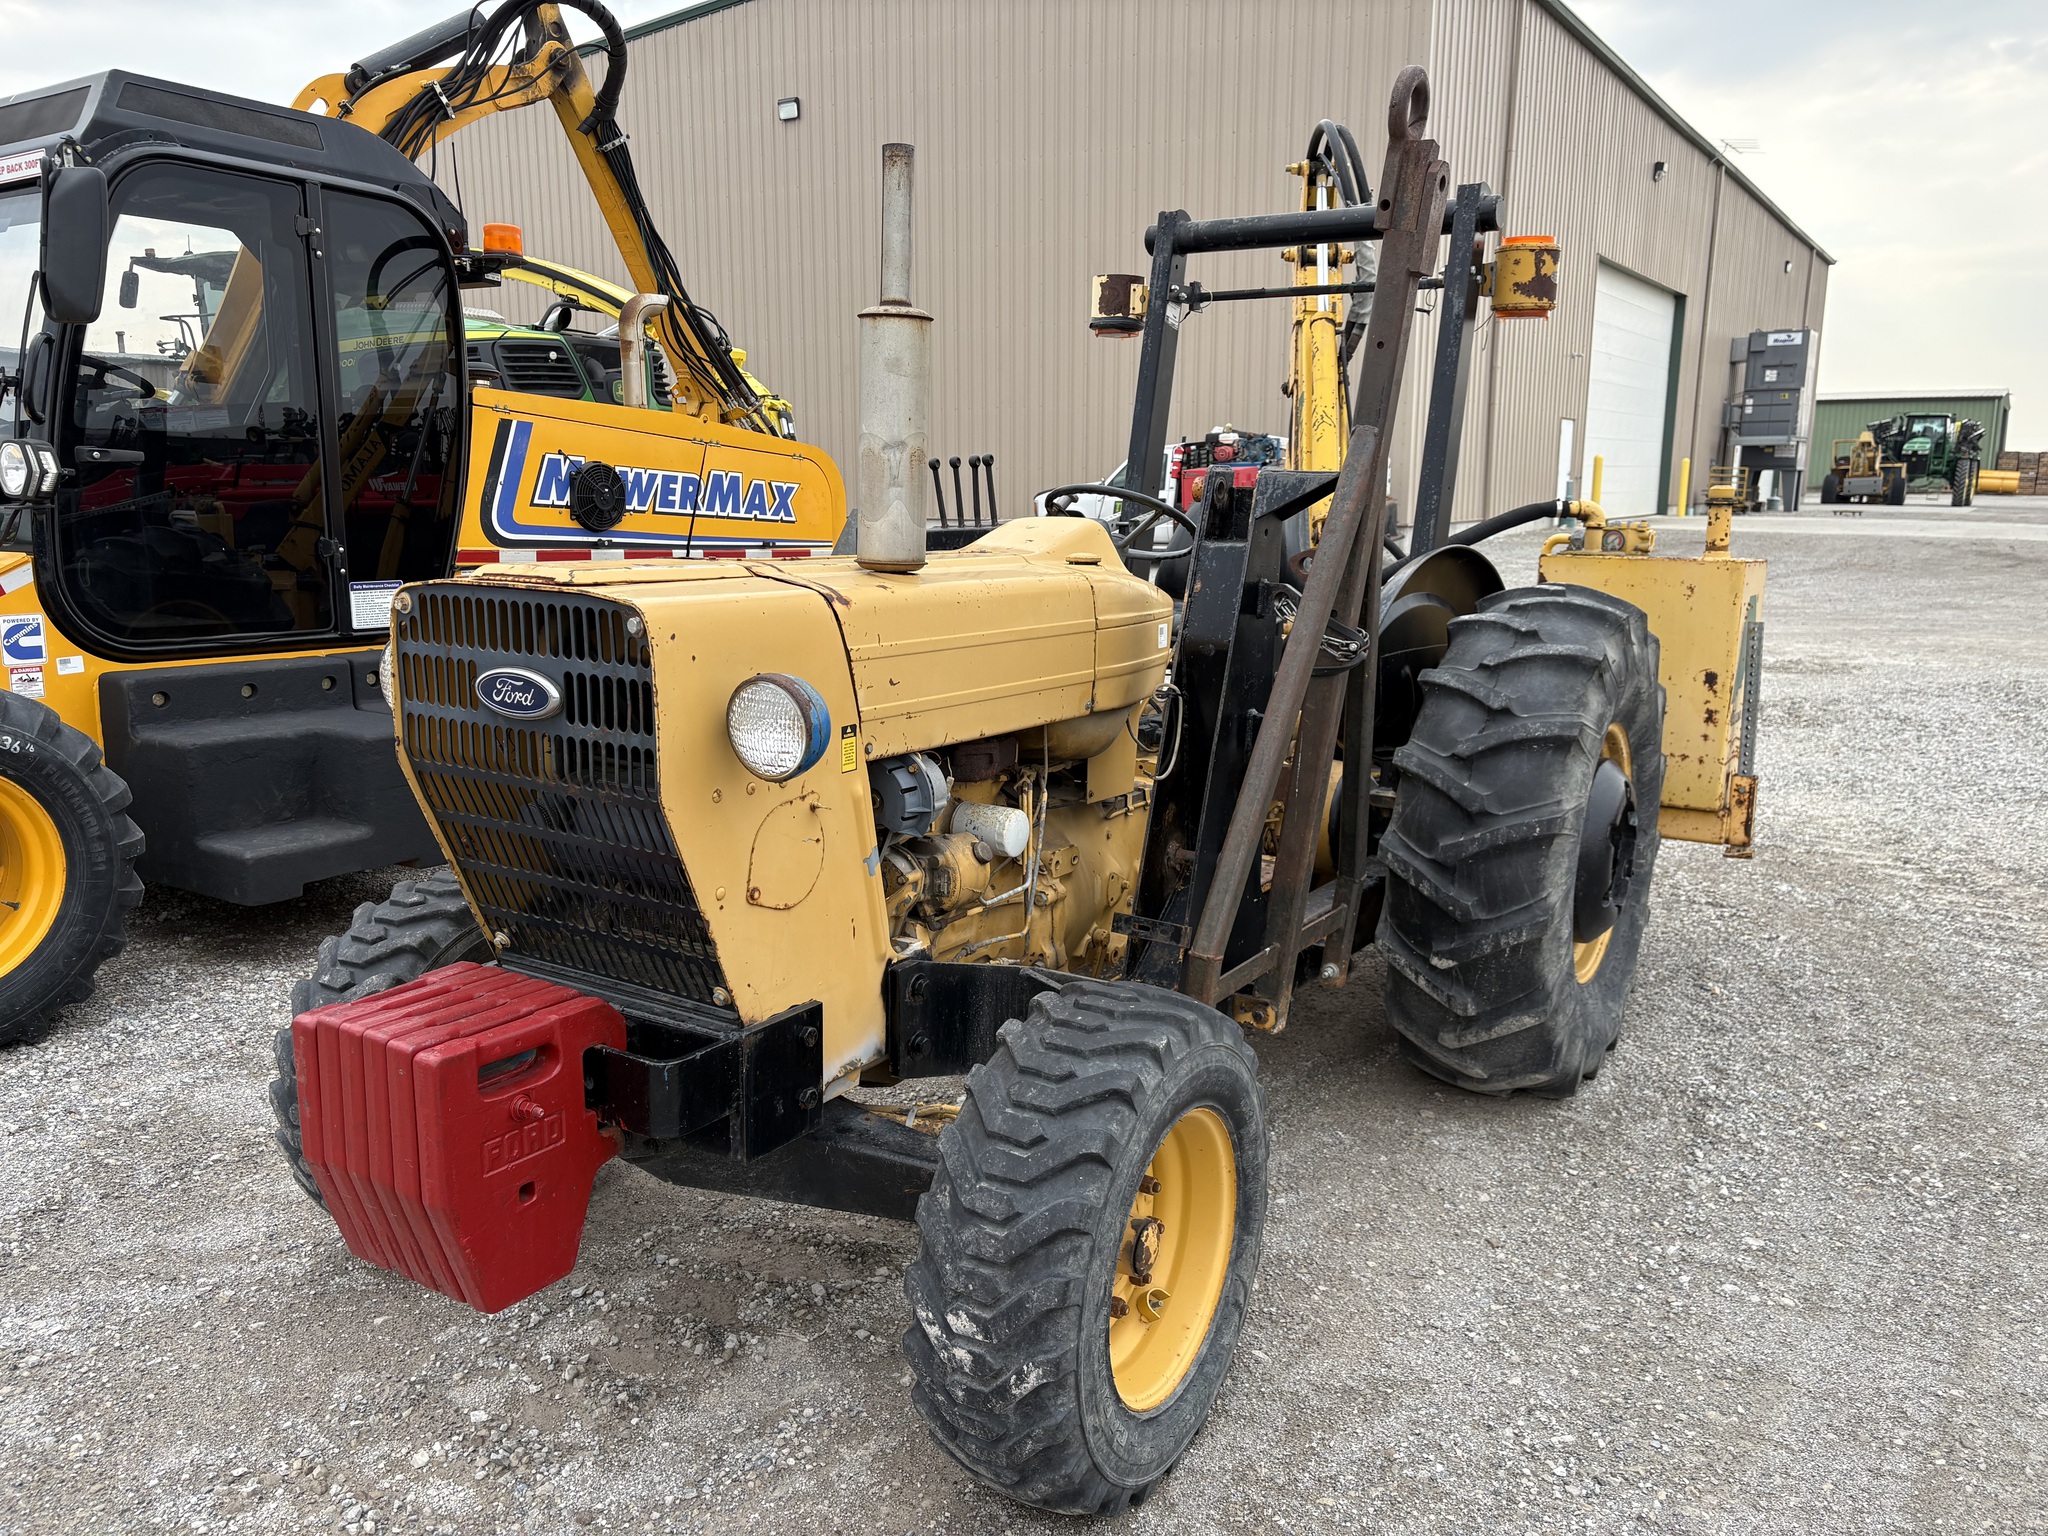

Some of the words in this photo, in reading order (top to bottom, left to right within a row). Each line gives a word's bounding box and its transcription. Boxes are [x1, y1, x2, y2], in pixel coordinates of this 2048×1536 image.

[6, 161, 23, 174] BACK
[353, 340, 375, 351] JOHN
[376, 336, 404, 346] DEERE
[530, 452, 800, 523] MWERMAX
[3, 622, 39, 647] Cummins
[492, 678, 535, 706] Ford
[483, 1113, 562, 1175] FORD
